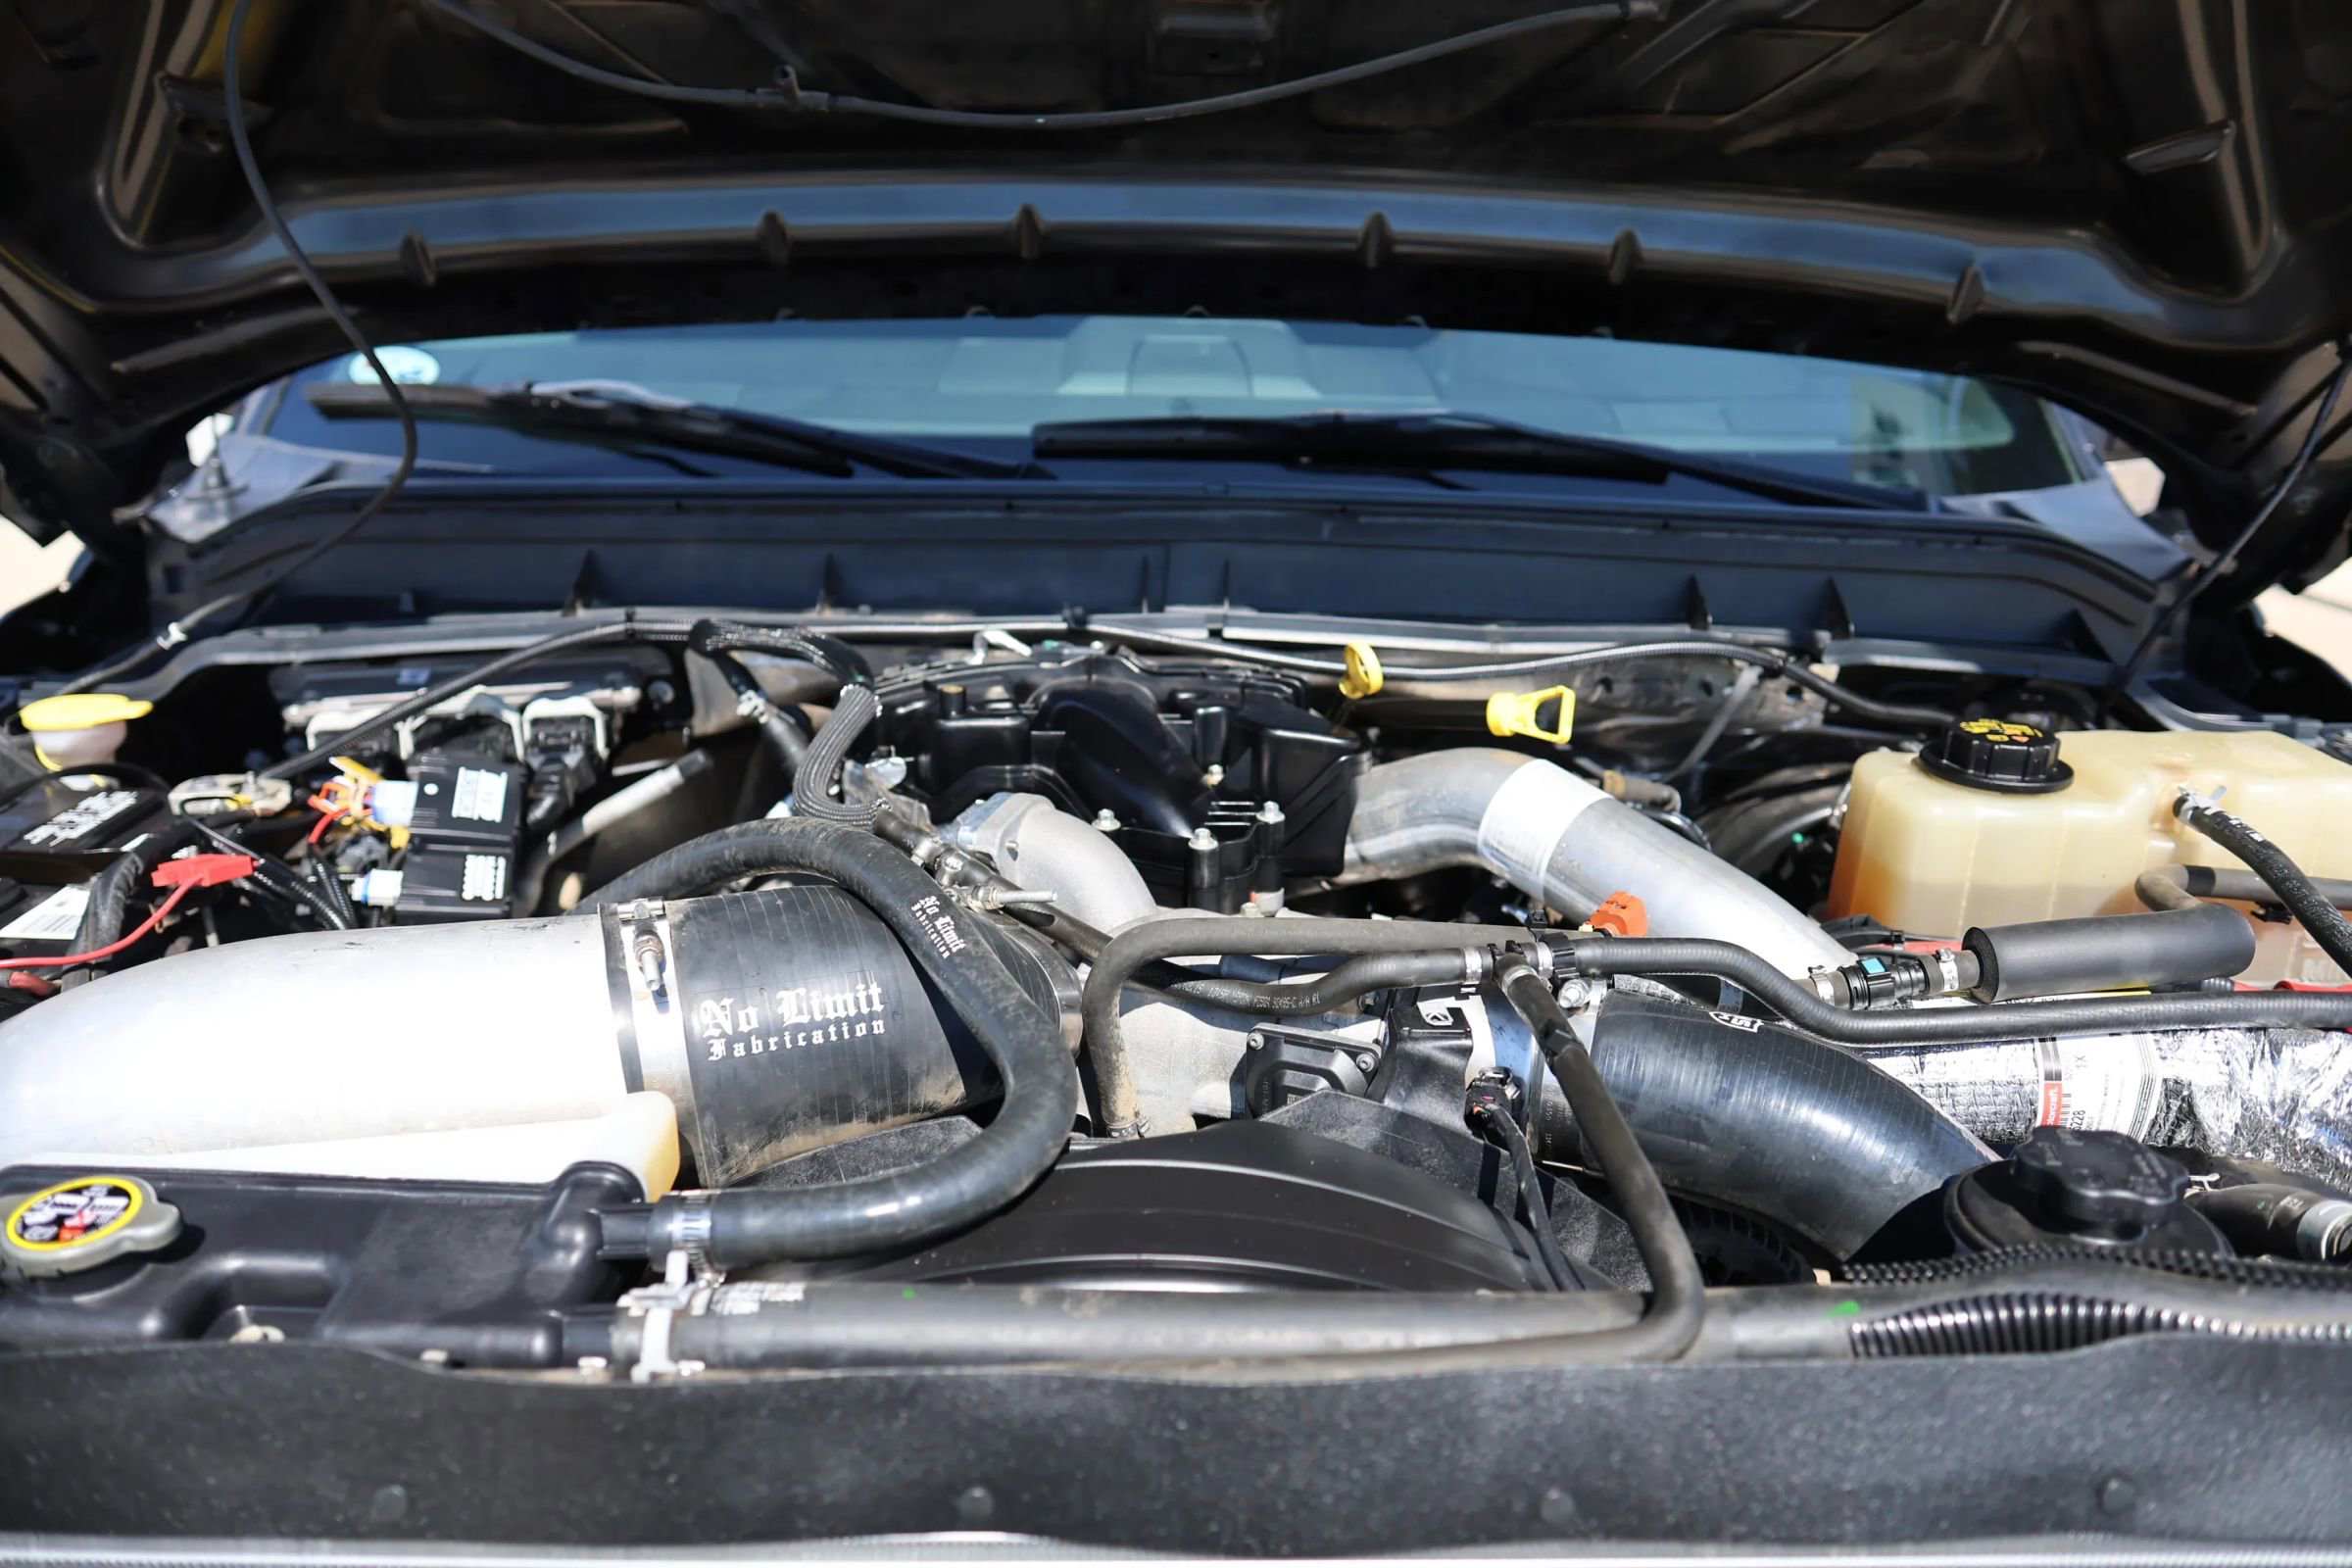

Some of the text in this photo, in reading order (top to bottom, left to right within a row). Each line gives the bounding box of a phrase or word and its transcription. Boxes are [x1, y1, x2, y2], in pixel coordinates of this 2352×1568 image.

[911, 903, 951, 958] Fabrication
[919, 896, 966, 953] No Limit
[700, 981, 885, 1038] No Limit
[708, 1019, 886, 1061] Fabrication
